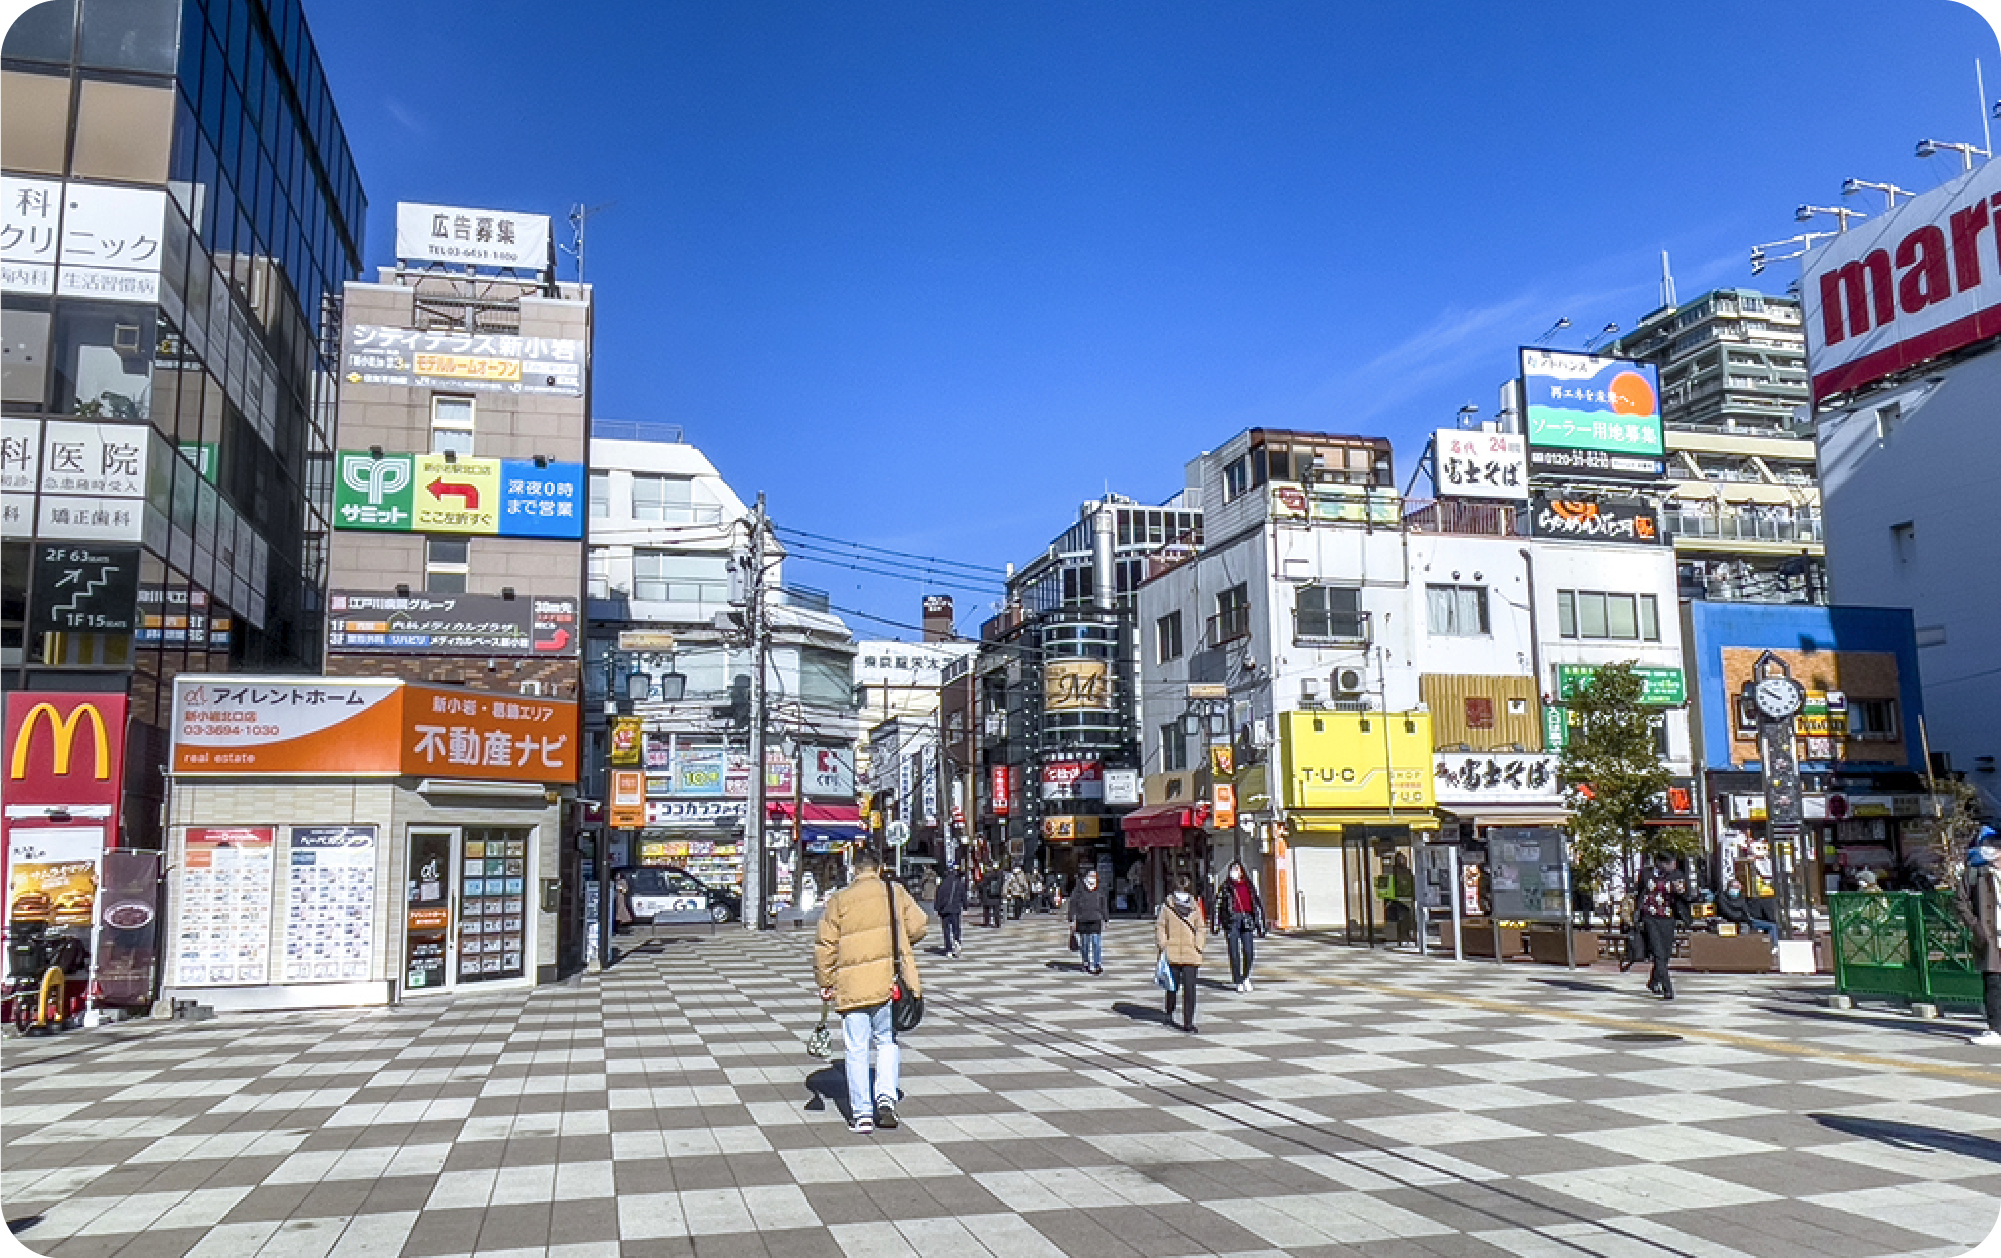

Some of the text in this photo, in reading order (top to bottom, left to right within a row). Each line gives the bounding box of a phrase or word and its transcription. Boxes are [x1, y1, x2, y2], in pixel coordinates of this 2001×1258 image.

[431, 213, 515, 244] 広告募集
[0, 223, 158, 262] クリニック
[354, 325, 576, 361] シティテラス新小岩
[417, 355, 519, 377] モデルルームオープン
[1532, 418, 1658, 444] ソーラー用地募集
[1443, 456, 1523, 487] 富士そば
[508, 479, 574, 497] 深夜0時
[51, 508, 130, 527] 矯正歯科
[340, 503, 408, 525] サミット
[419, 509, 493, 526] ここ左折すぐ
[507, 499, 574, 518] まで営業
[46, 548, 67, 562] 2F
[349, 596, 457, 611] 江戸川病院グループ
[66, 613, 84, 626] 1F
[330, 620, 344, 631] 1F
[390, 634, 427, 646] リハビリ
[212, 687, 365, 706] アイレントホーム
[184, 711, 258, 723] 新小岩北口店
[183, 724, 280, 737] 03-3694-1030
[413, 724, 568, 769] 不動産ナビ
[184, 752, 256, 764] real estate
[1460, 758, 1550, 792] 富士そば
